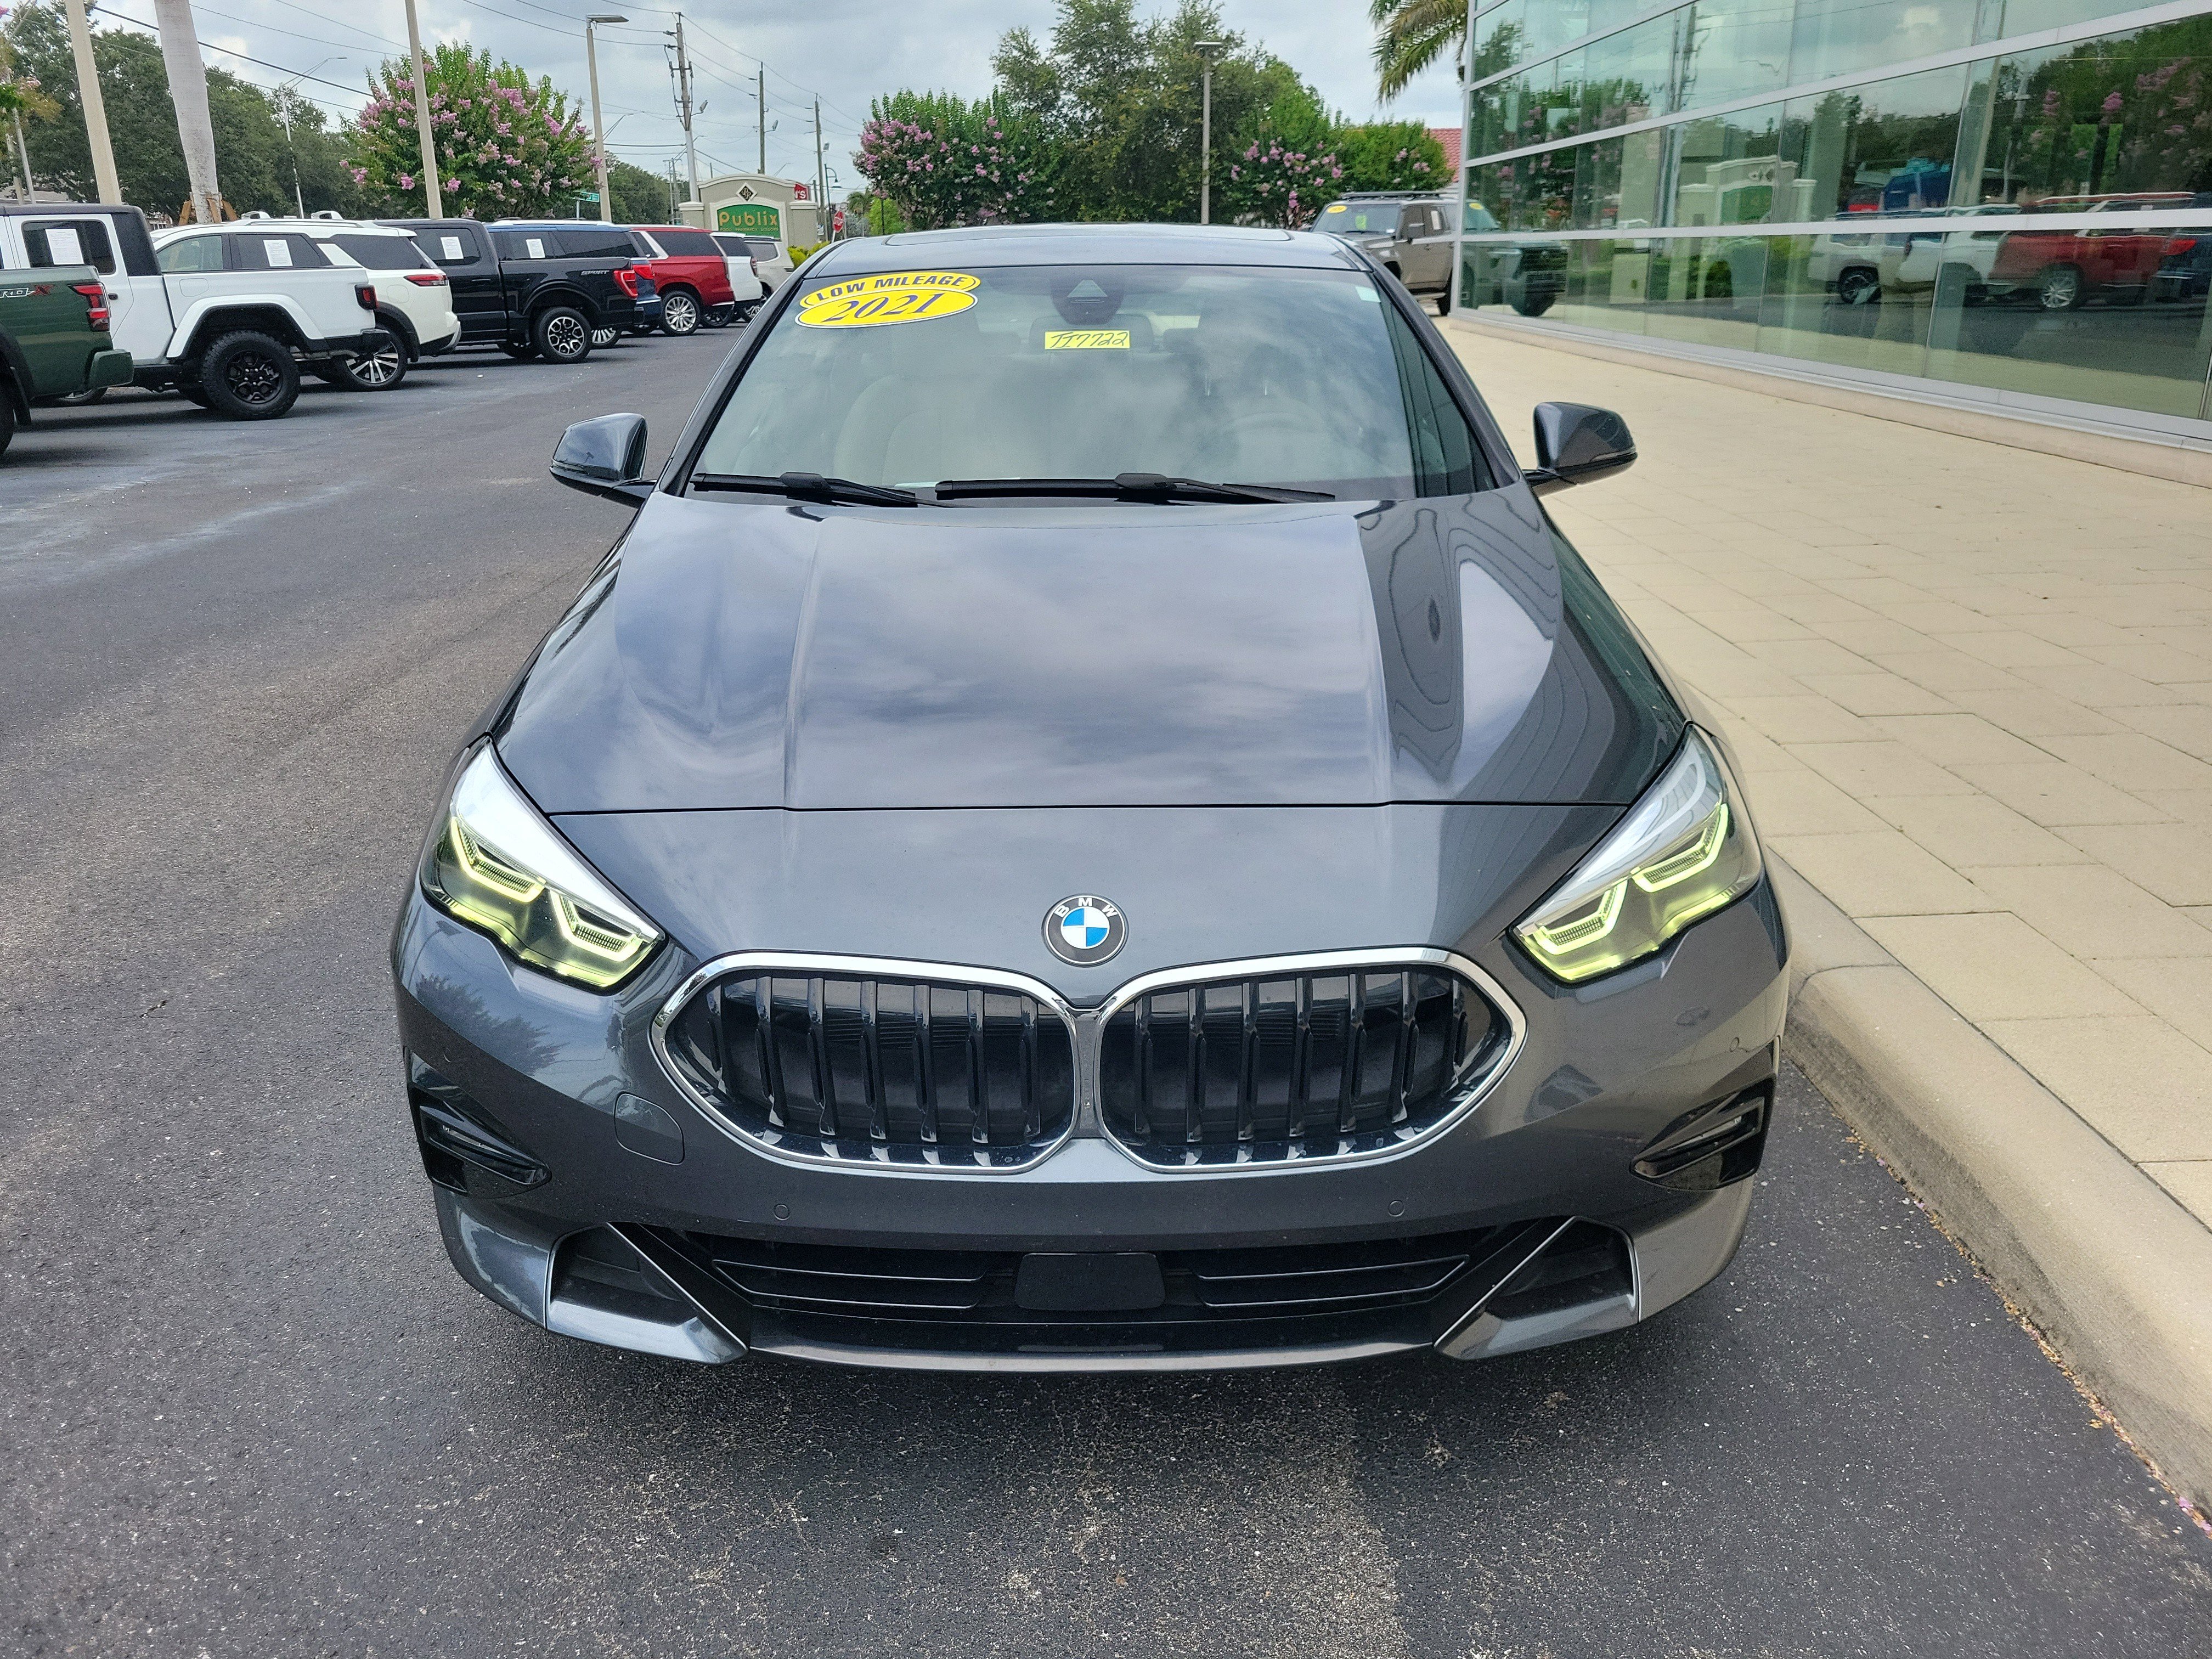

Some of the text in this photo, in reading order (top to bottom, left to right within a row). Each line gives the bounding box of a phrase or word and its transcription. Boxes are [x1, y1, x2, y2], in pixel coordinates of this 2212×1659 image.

[719, 211, 778, 227] Publix
[816, 275, 968, 301] LOW MILEAGE
[820, 292, 946, 323] 2021
[1054, 898, 1118, 918] BMW
